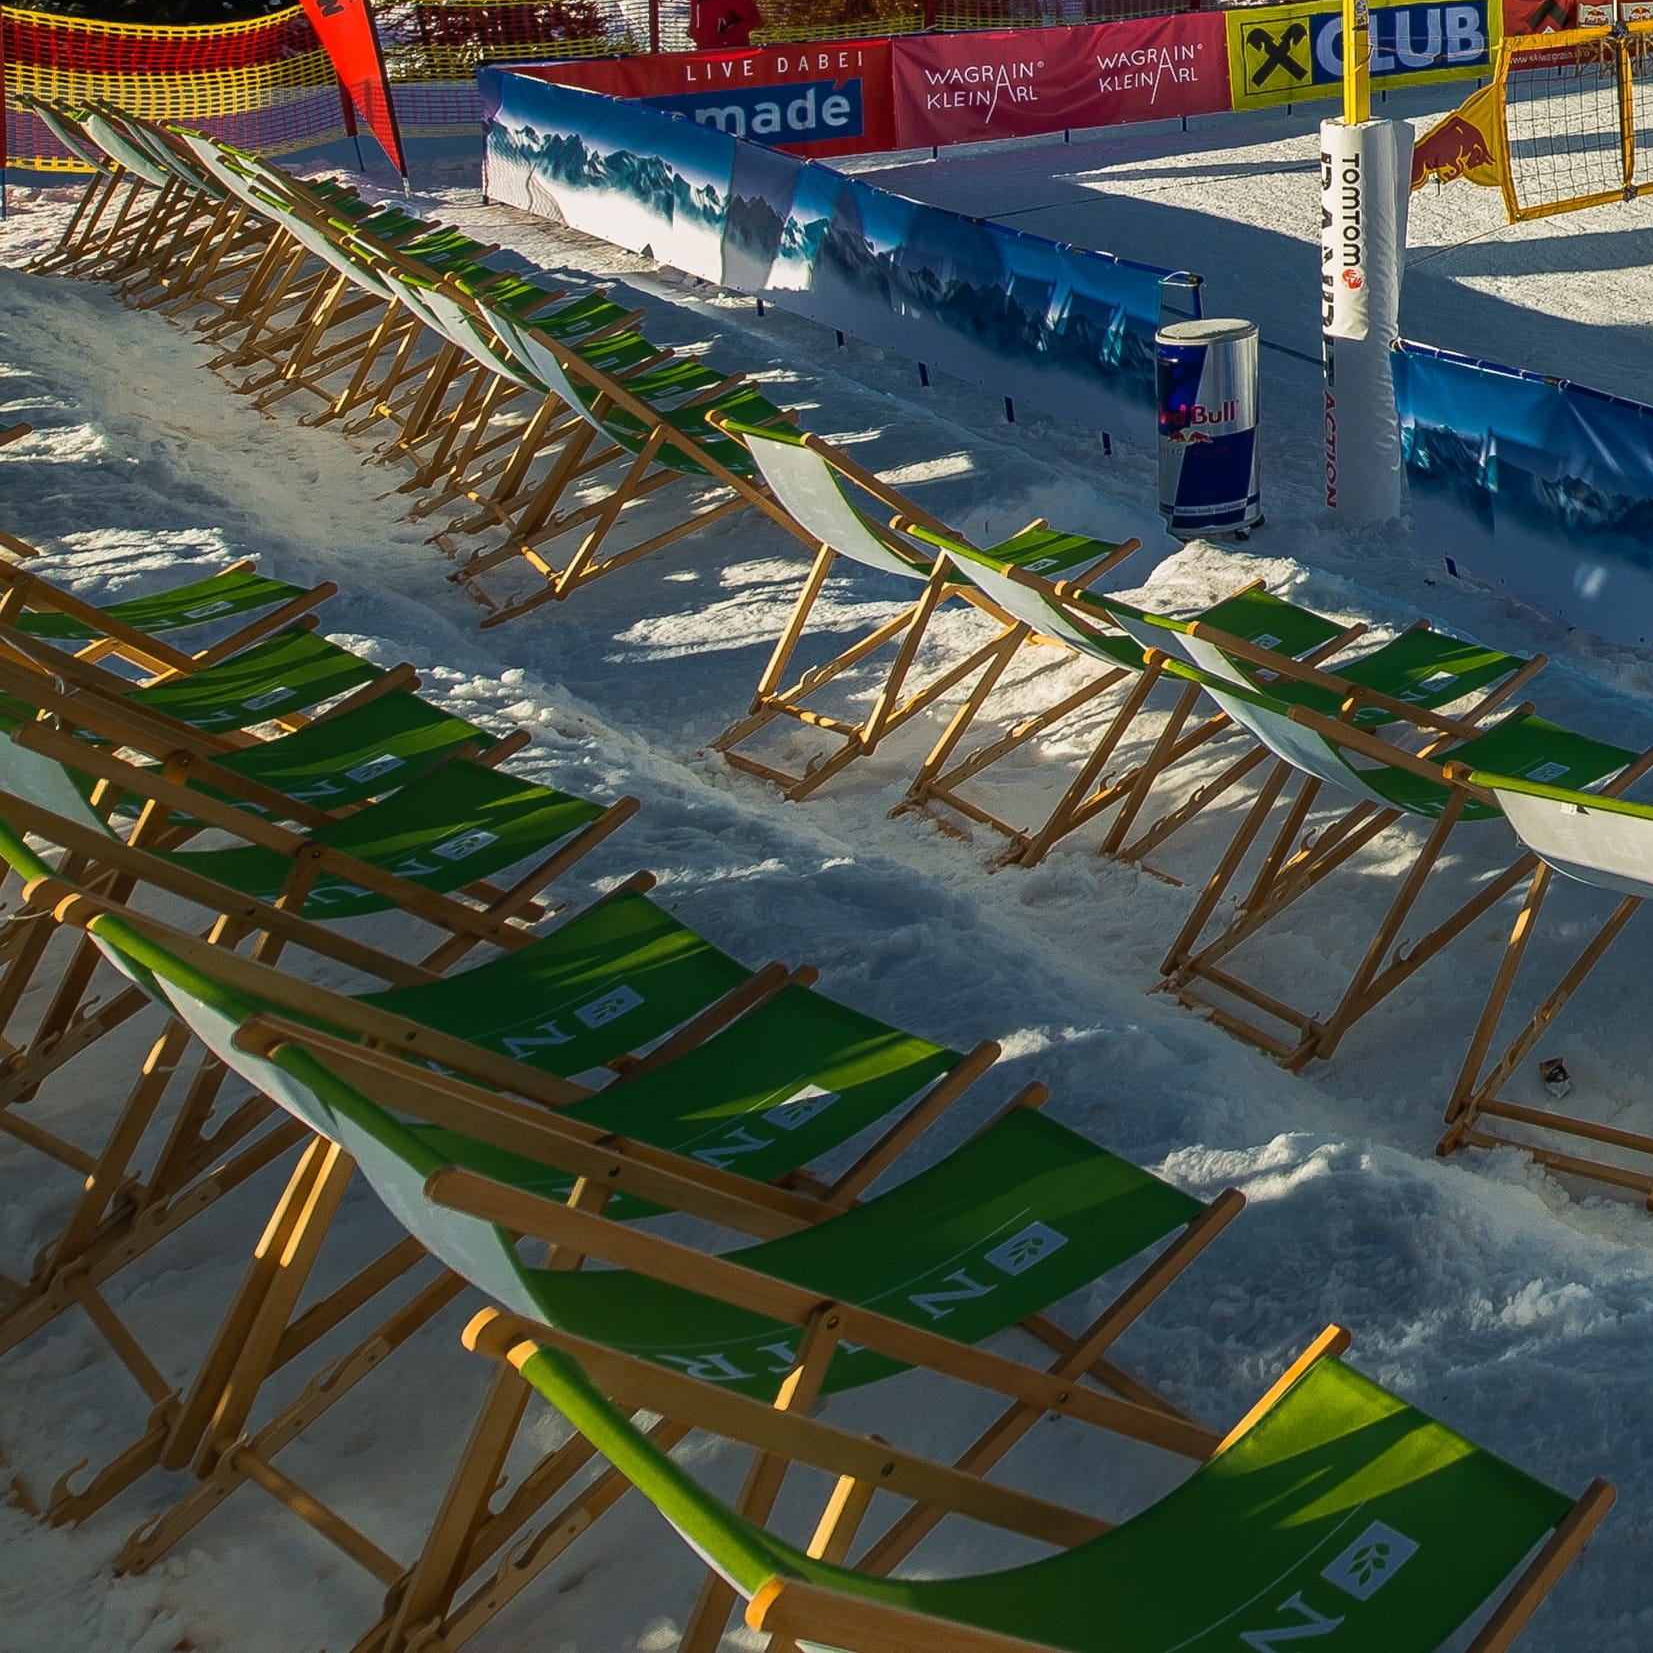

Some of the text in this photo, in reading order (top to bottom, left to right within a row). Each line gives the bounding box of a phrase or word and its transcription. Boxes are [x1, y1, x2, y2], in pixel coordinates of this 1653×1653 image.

[686, 50, 864, 82] LIVE DABEI
[1190, 401, 1236, 425] Bull
[1323, 388, 1338, 510] ACTION
